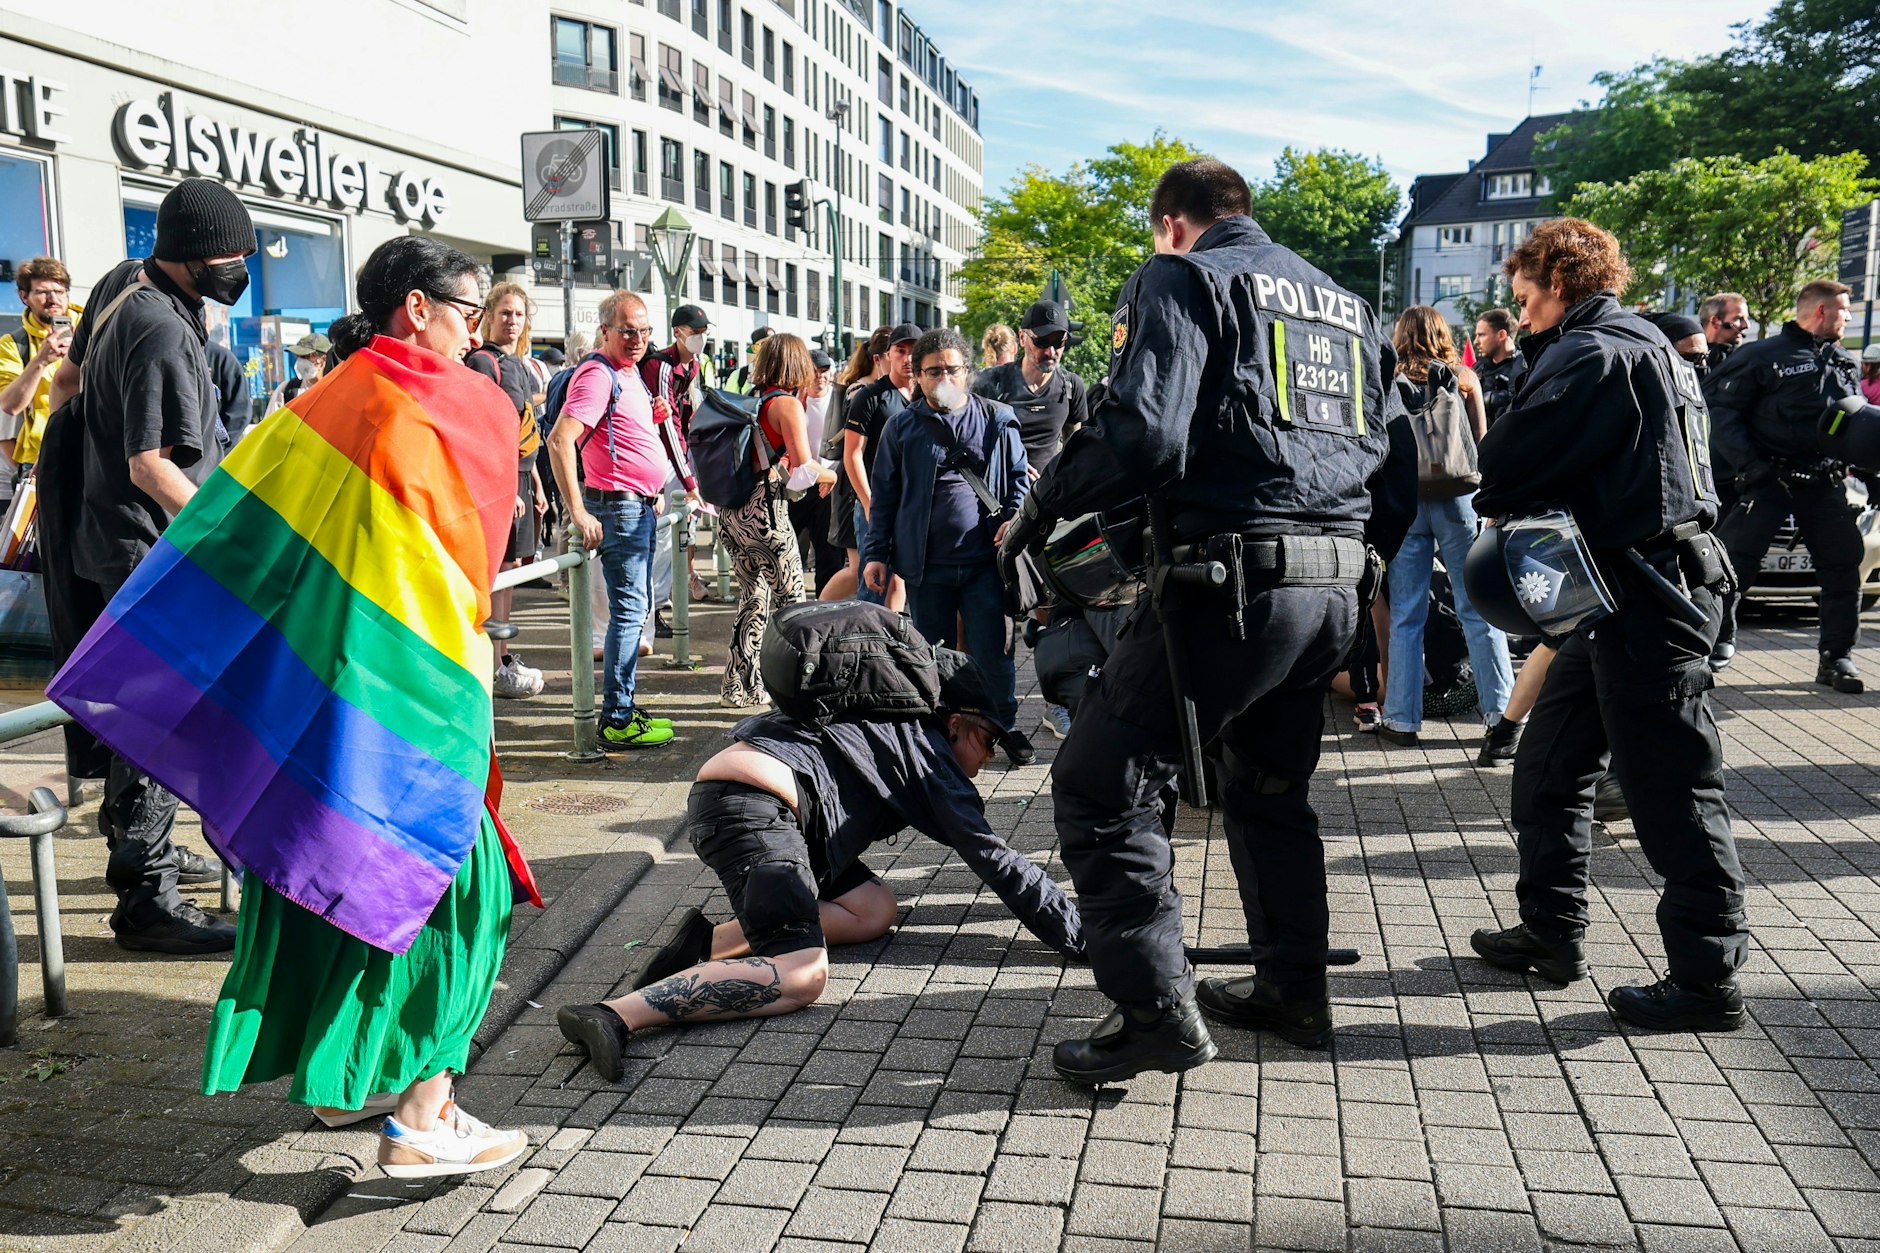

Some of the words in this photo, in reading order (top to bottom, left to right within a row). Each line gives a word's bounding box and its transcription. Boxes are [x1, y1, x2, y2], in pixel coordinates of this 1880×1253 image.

[115, 90, 380, 209] elsweiler
[1253, 273, 1363, 334] POLIZEI
[1308, 334, 1332, 365] HB
[1296, 363, 1348, 394] 23121
[1321, 402, 1329, 420] 5
[1778, 555, 1798, 570] QF
